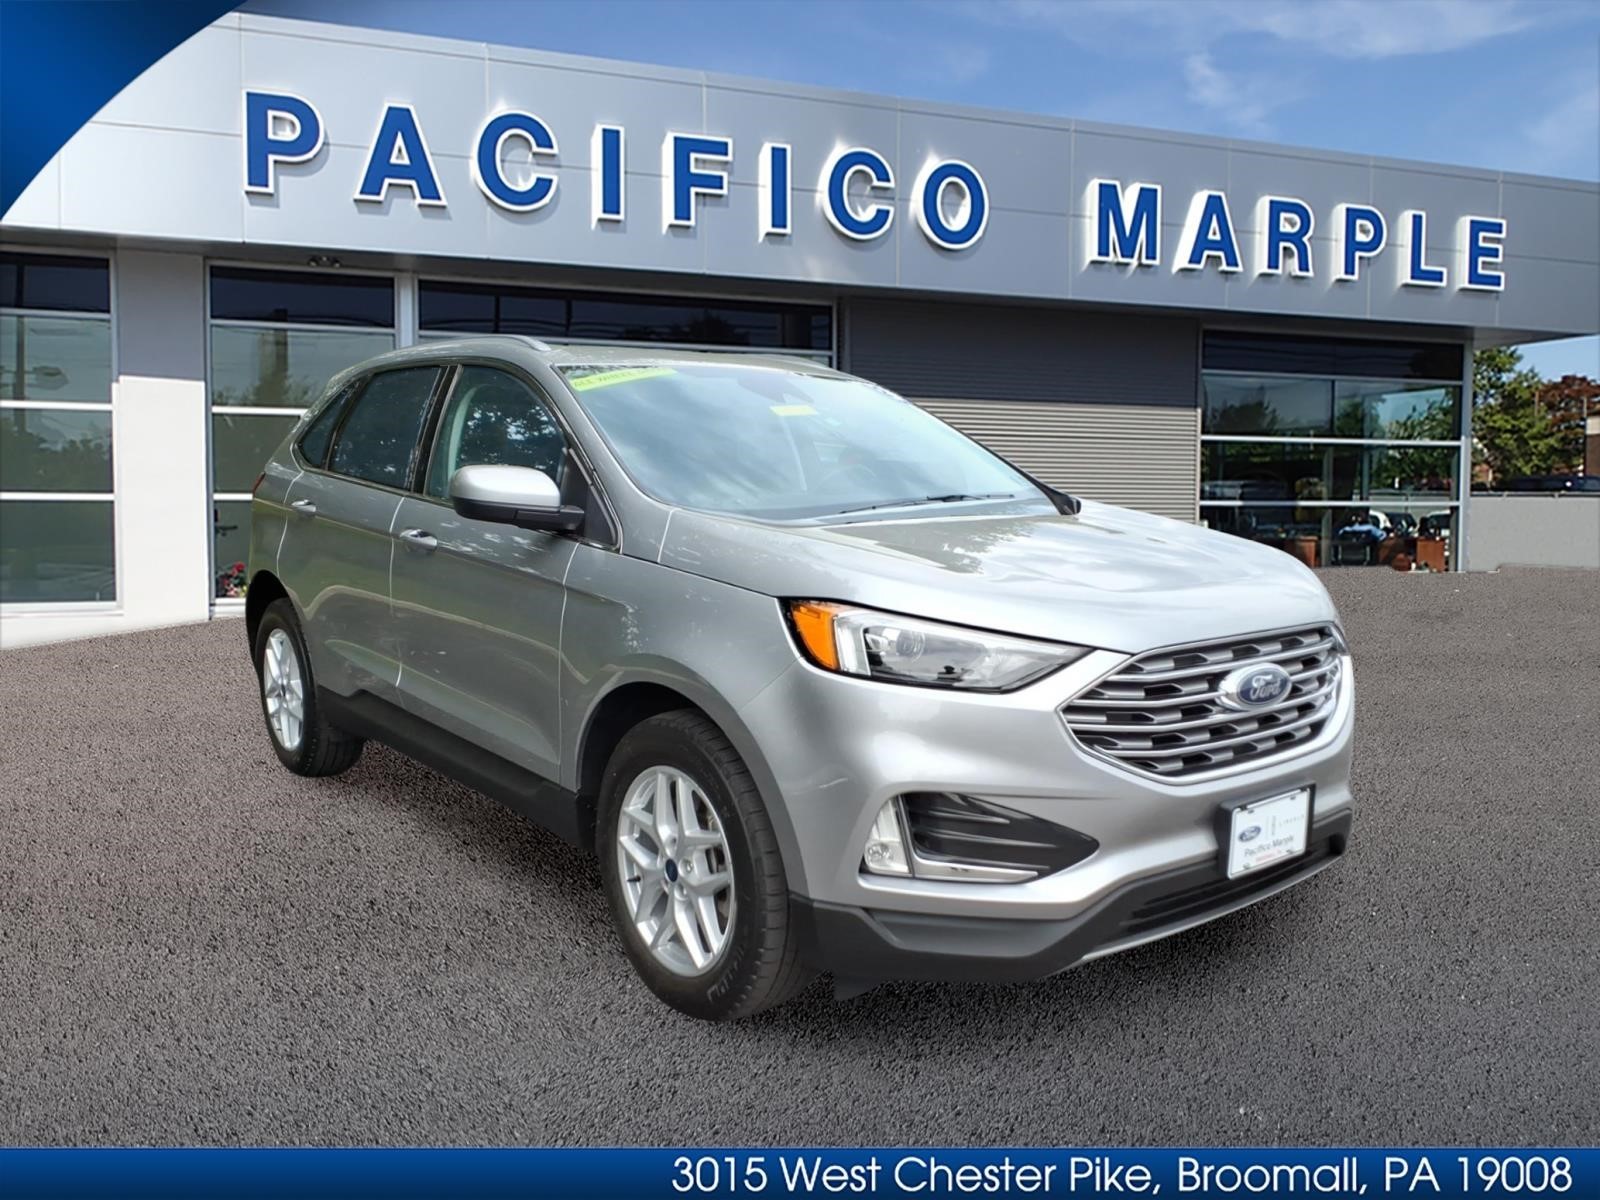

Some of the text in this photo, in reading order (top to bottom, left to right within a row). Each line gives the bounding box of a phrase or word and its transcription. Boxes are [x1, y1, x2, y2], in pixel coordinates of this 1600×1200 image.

[243, 88, 1507, 292] PACIFICO MARPLE
[1249, 674, 1282, 701] Ford
